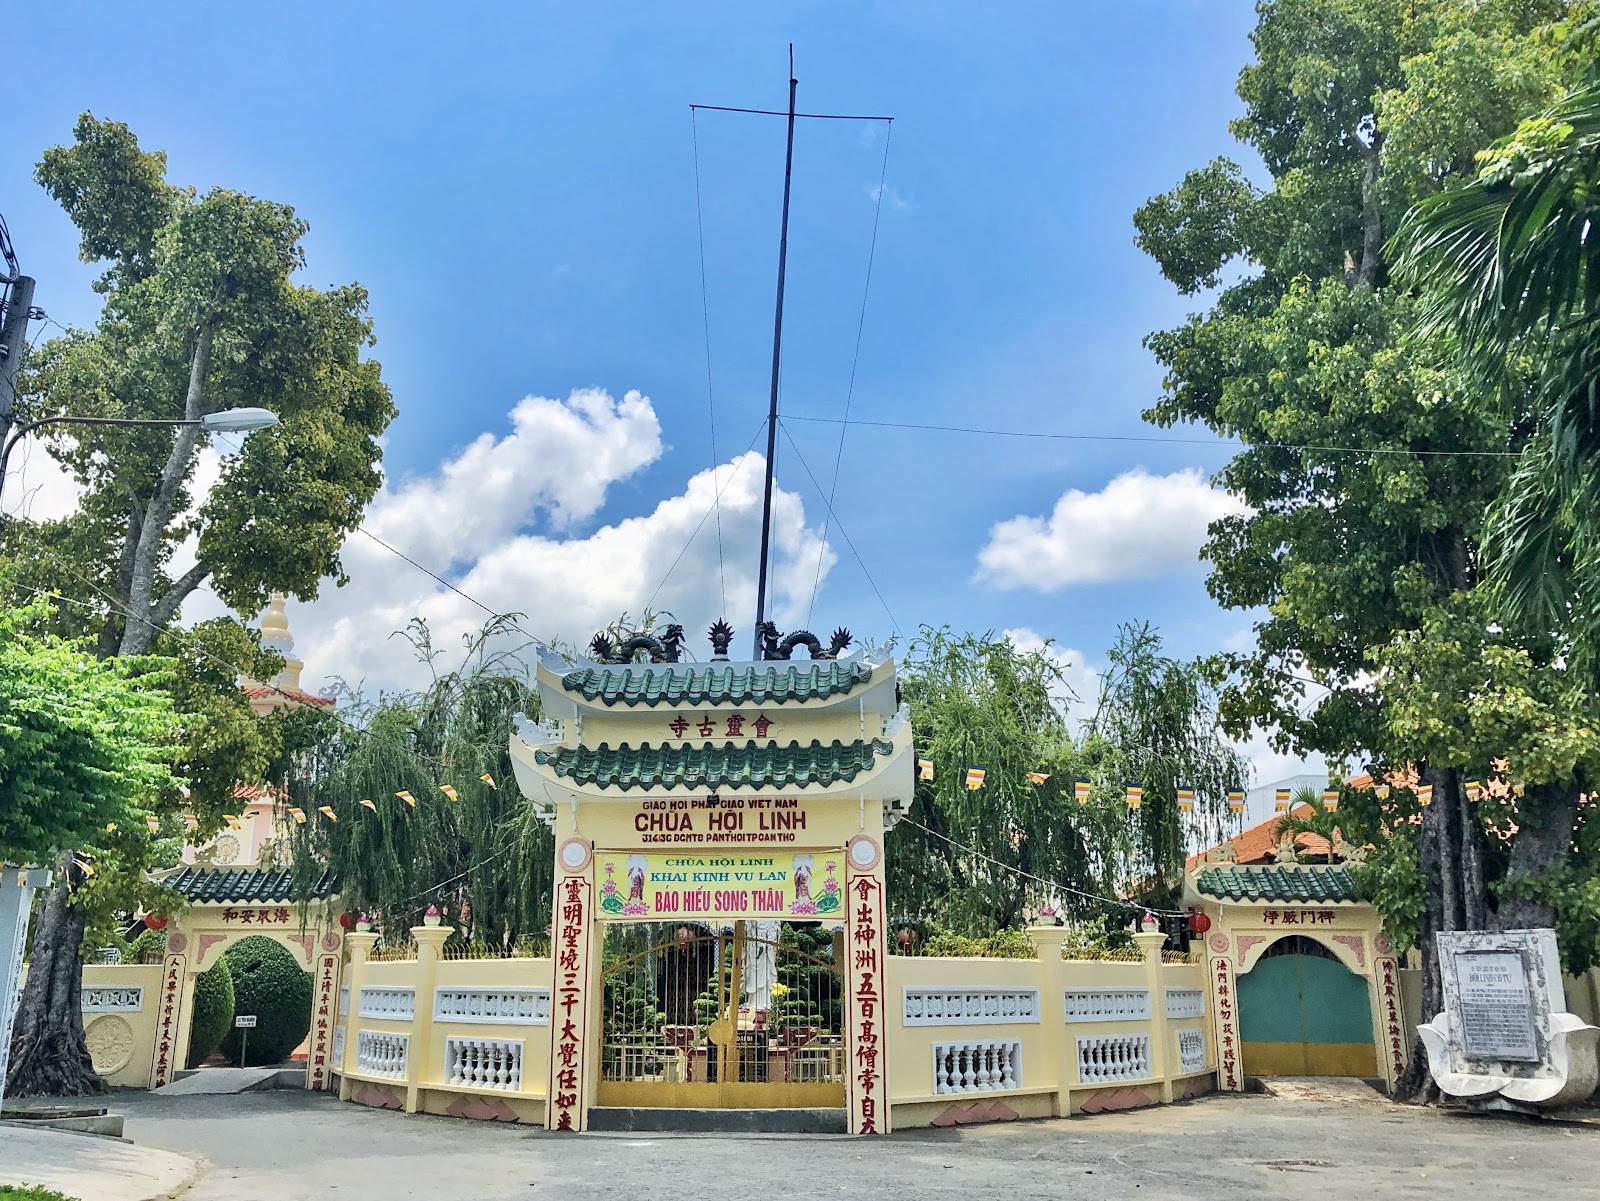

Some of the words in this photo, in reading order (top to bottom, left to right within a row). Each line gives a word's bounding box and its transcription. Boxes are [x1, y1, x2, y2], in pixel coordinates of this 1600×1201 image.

[774, 799, 798, 808] NAM
[634, 811, 693, 832] CHÙA
[708, 809, 744, 833] HỘI
[759, 811, 806, 830] LINH
[665, 858, 706, 867] CHÙA
[709, 858, 735, 868] HỘI
[740, 858, 774, 866] LINH
[650, 872, 688, 882] KHAI
[692, 872, 730, 882] KINH
[734, 872, 754, 881] VU
[758, 871, 787, 881] LAN
[683, 885, 711, 912] HIẾU
[714, 890, 748, 912] SONG
[751, 887, 784, 911] THÂN
